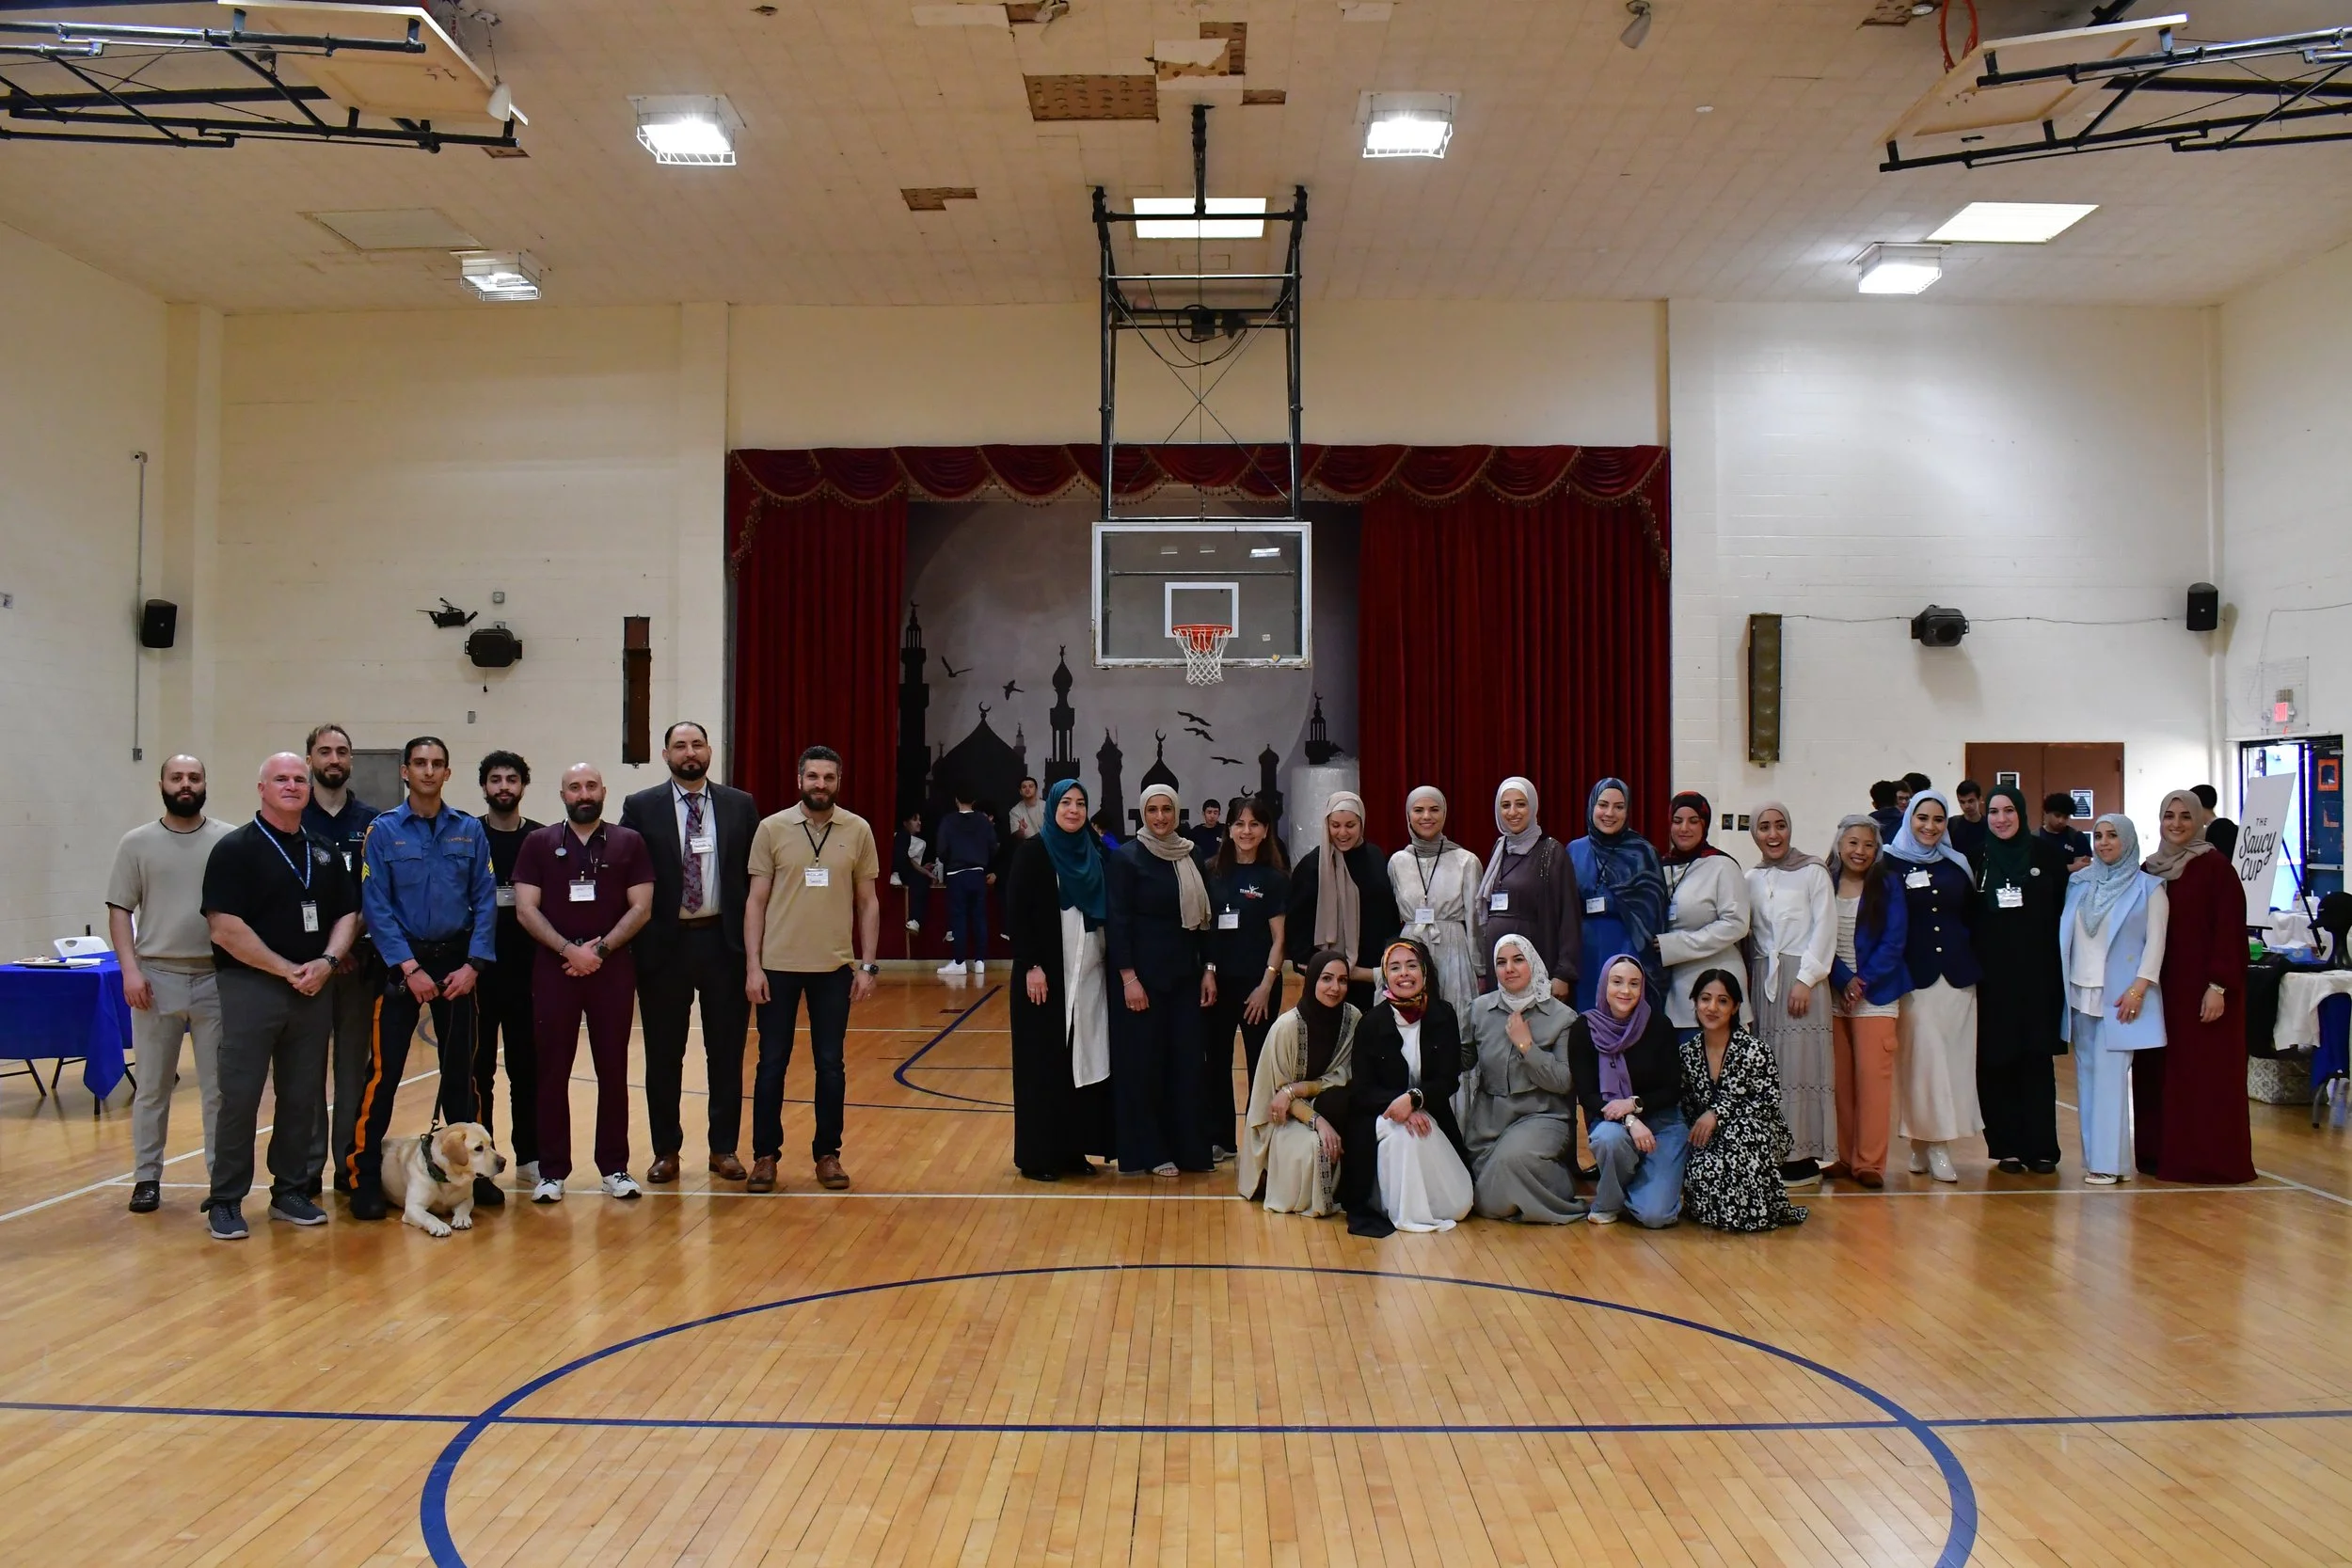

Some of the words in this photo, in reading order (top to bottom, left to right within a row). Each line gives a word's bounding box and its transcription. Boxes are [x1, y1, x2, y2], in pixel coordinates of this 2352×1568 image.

[2256, 817, 2267, 826] THE
[2239, 826, 2277, 865] Saucy
[2241, 858, 2263, 880] CUP
